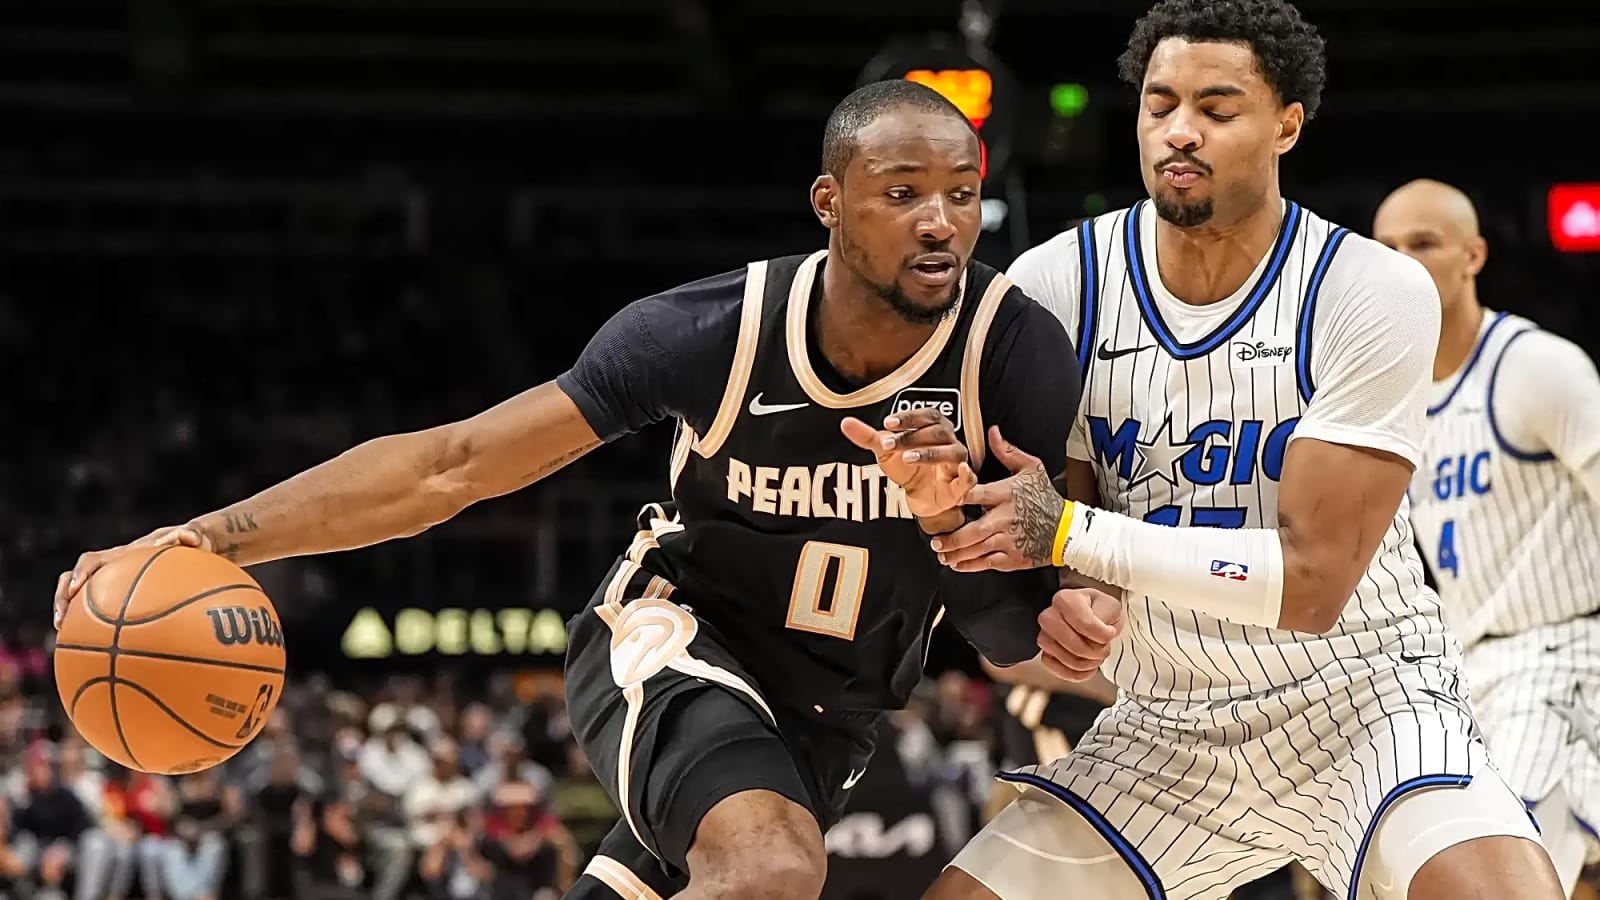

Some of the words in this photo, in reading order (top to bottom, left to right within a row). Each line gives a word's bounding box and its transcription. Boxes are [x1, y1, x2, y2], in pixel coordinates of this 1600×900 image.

[727, 457, 914, 522] PEACHTR
[1438, 519, 1458, 578] 4
[785, 541, 869, 641] 0
[207, 606, 285, 648] Wils
